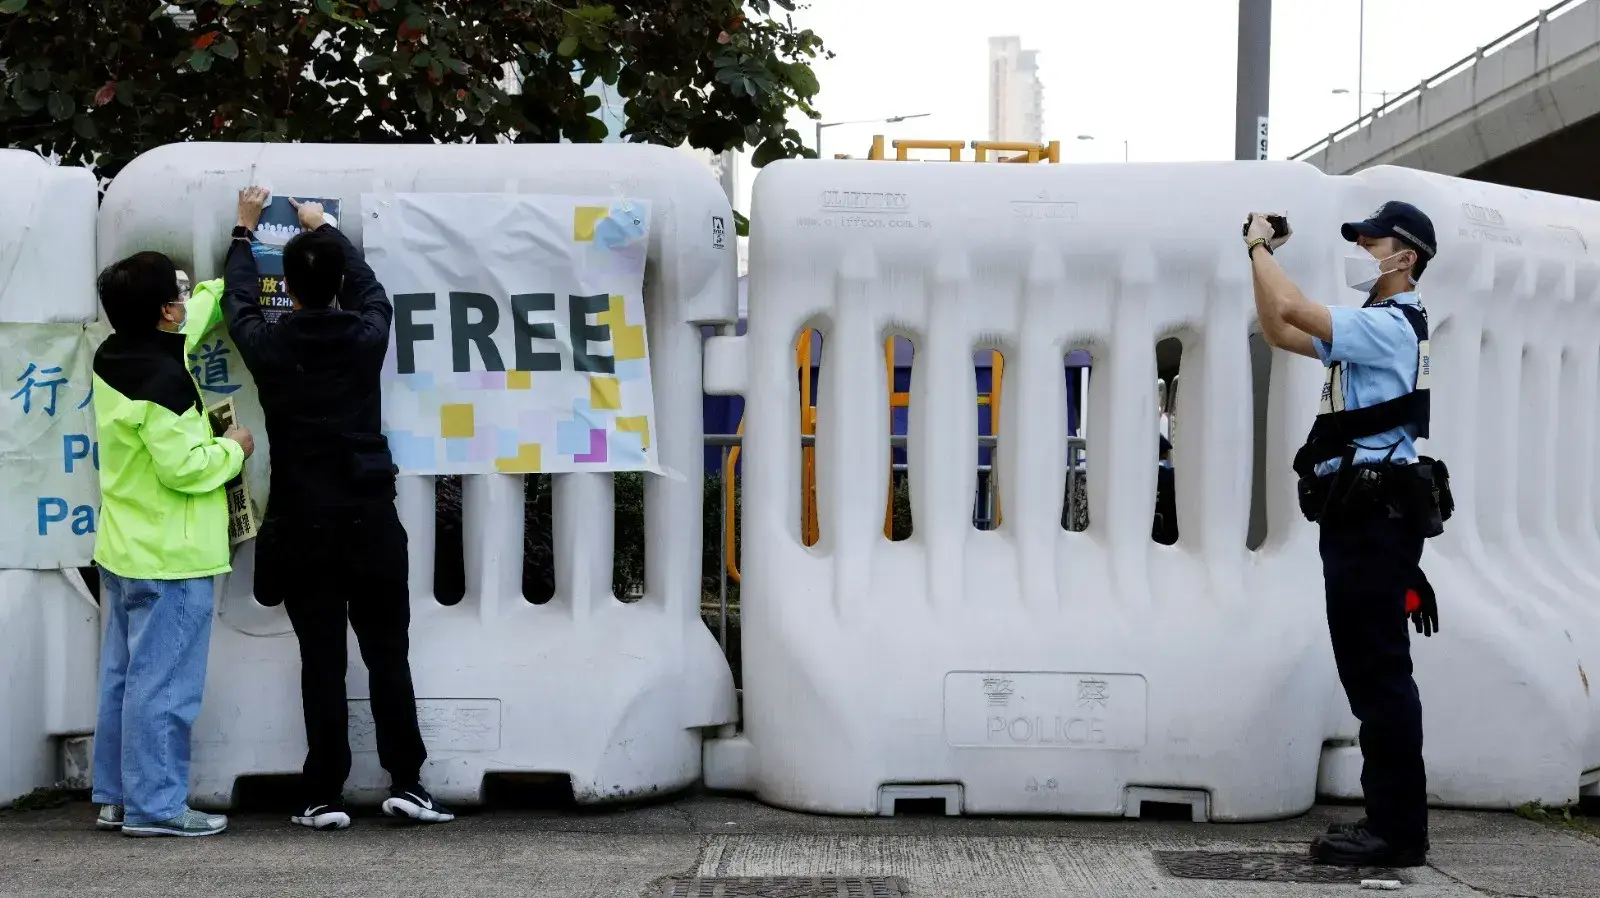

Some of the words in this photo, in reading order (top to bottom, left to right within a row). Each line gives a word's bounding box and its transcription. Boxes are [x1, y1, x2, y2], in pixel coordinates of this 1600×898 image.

[392, 291, 616, 375] FREE
[36, 497, 98, 536] Pa
[982, 677, 1110, 711] 警察
[986, 716, 1106, 744] POLICE
